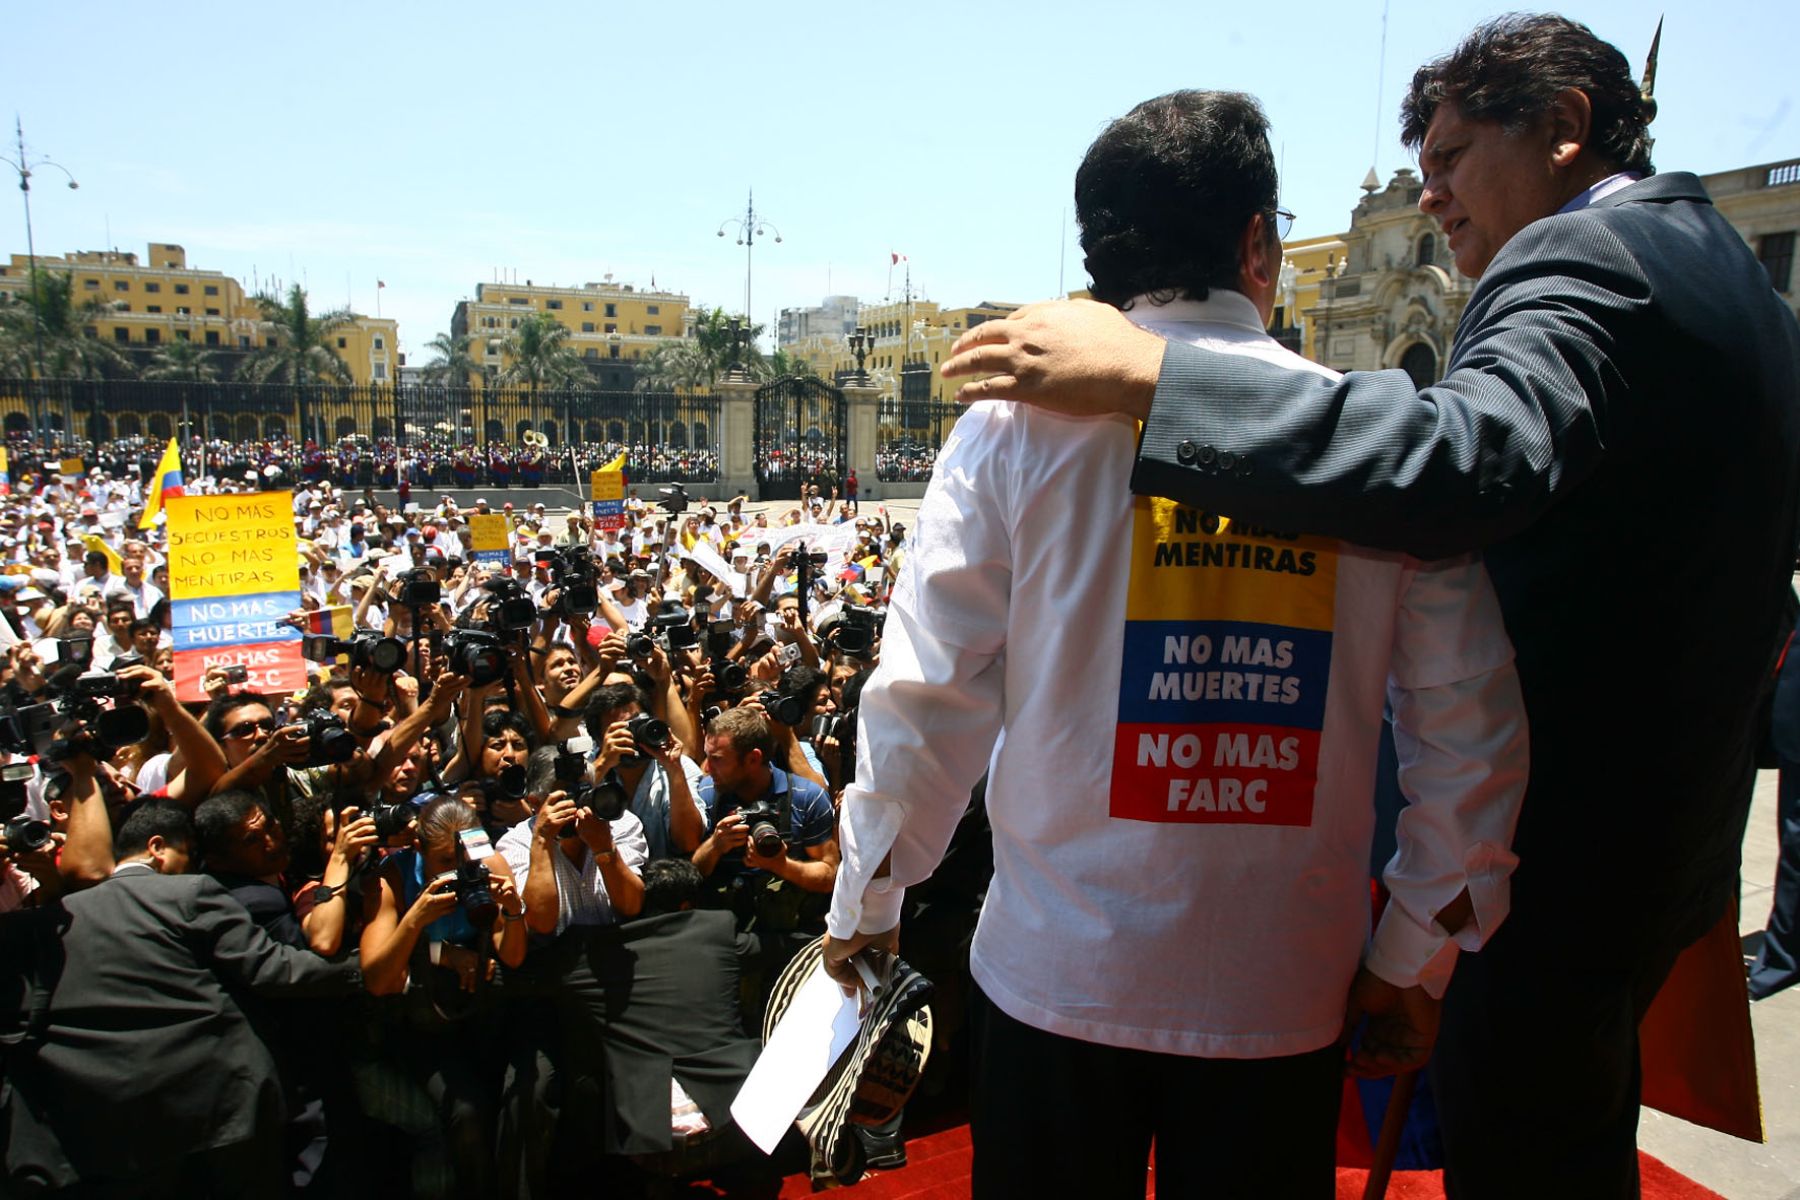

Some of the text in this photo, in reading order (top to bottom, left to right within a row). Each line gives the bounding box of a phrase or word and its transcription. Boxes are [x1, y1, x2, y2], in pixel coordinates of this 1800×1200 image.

[195, 504, 275, 522] NO MAS
[1175, 508, 1220, 536] NO
[170, 526, 290, 546] SECUESTROS
[180, 548, 274, 568] NO MAS
[1154, 542, 1317, 577] MENTIRAS
[175, 570, 274, 590] MENTIRAS
[191, 600, 279, 623] NO MAS
[203, 649, 280, 670] NO MAS
[1163, 635, 1294, 670] NO MAS
[1148, 672, 1301, 706] MUERTES
[1136, 734, 1300, 772] NO MAS
[1166, 778, 1269, 814] FARC
